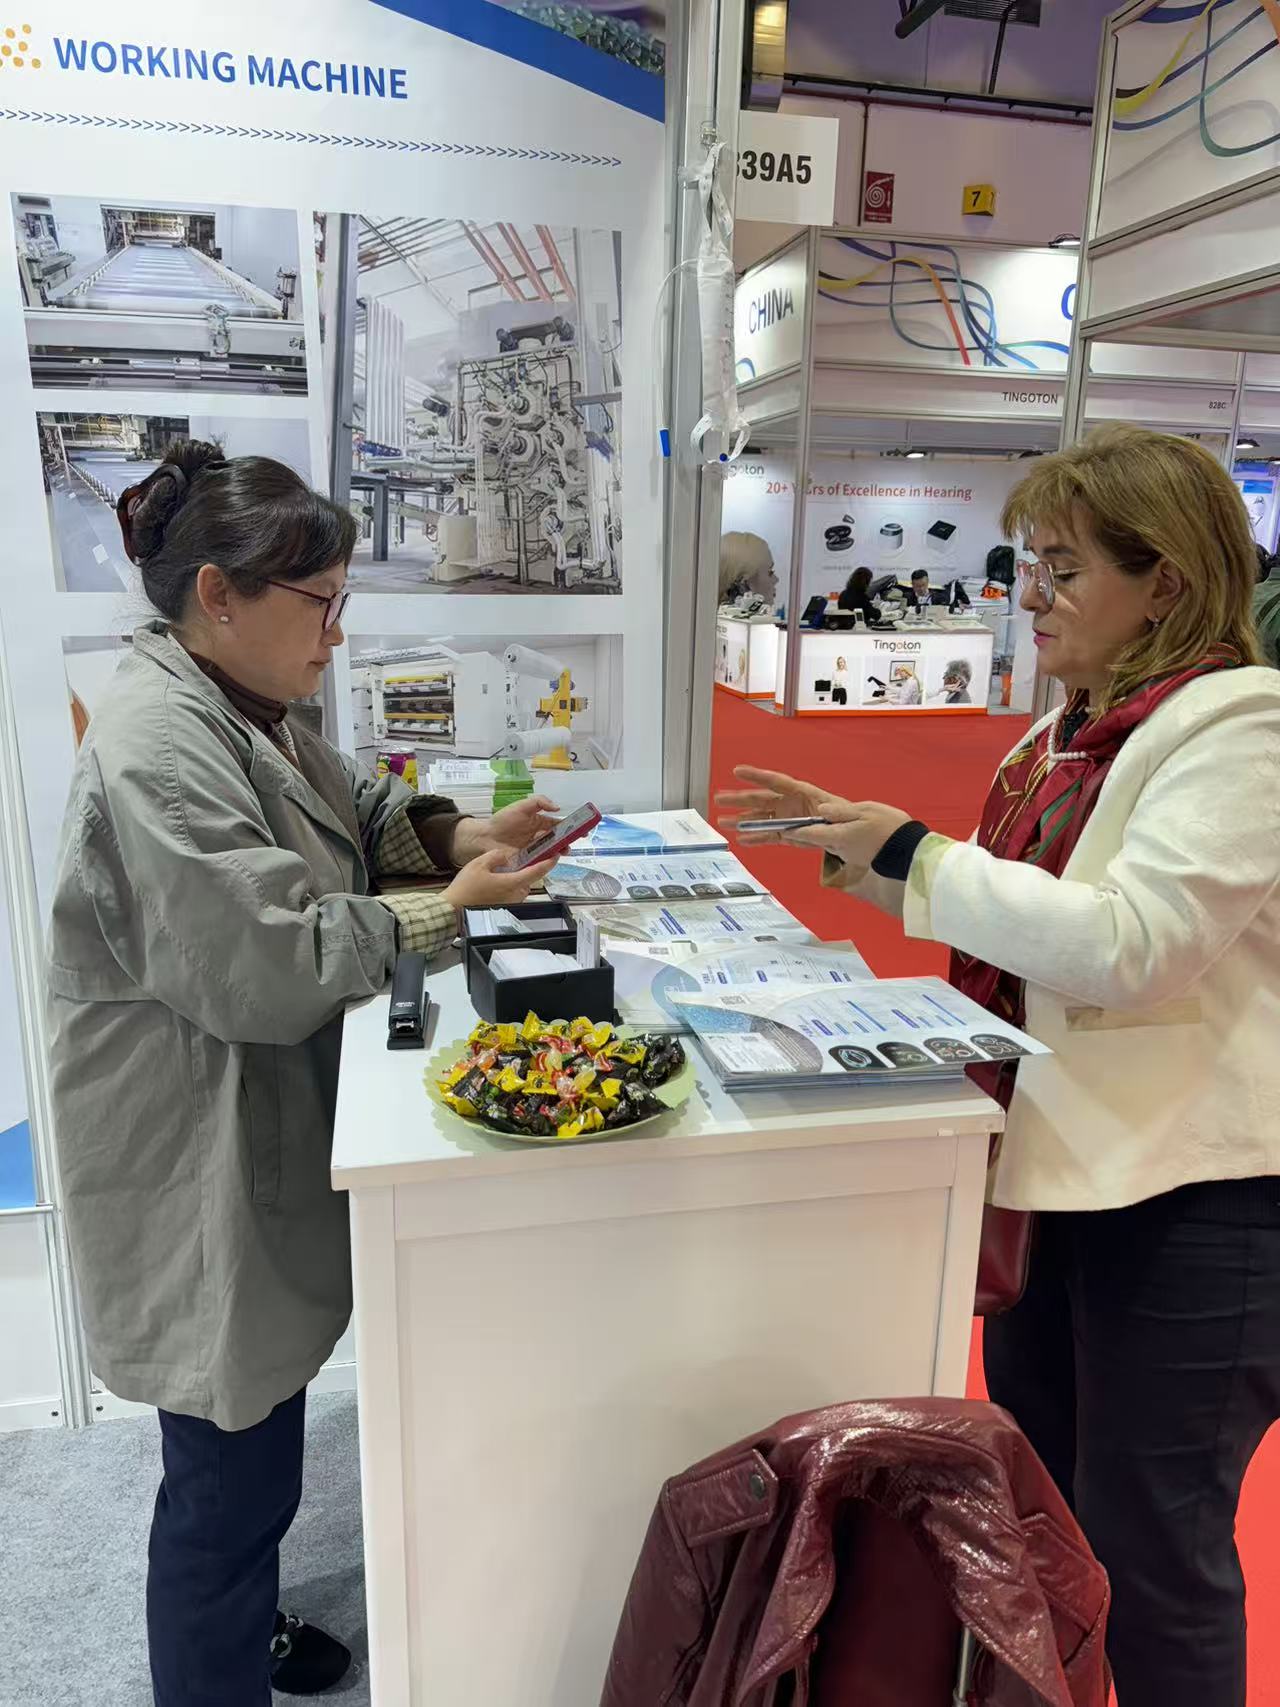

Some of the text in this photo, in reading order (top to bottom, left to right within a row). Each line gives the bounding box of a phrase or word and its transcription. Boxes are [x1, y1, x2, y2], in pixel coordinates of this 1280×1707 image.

[53, 37, 408, 99] WORKING MACHINE
[737, 150, 811, 184] 39A5
[972, 191, 981, 207] 7
[749, 287, 794, 334] CHINA
[1002, 391, 1058, 404] TINGOTON
[766, 482, 788, 494] 20+
[828, 482, 840, 495] of
[843, 484, 906, 497] Excellence
[909, 485, 921, 497] in
[924, 486, 972, 501] Hearing
[874, 640, 921, 652] Tingoton
